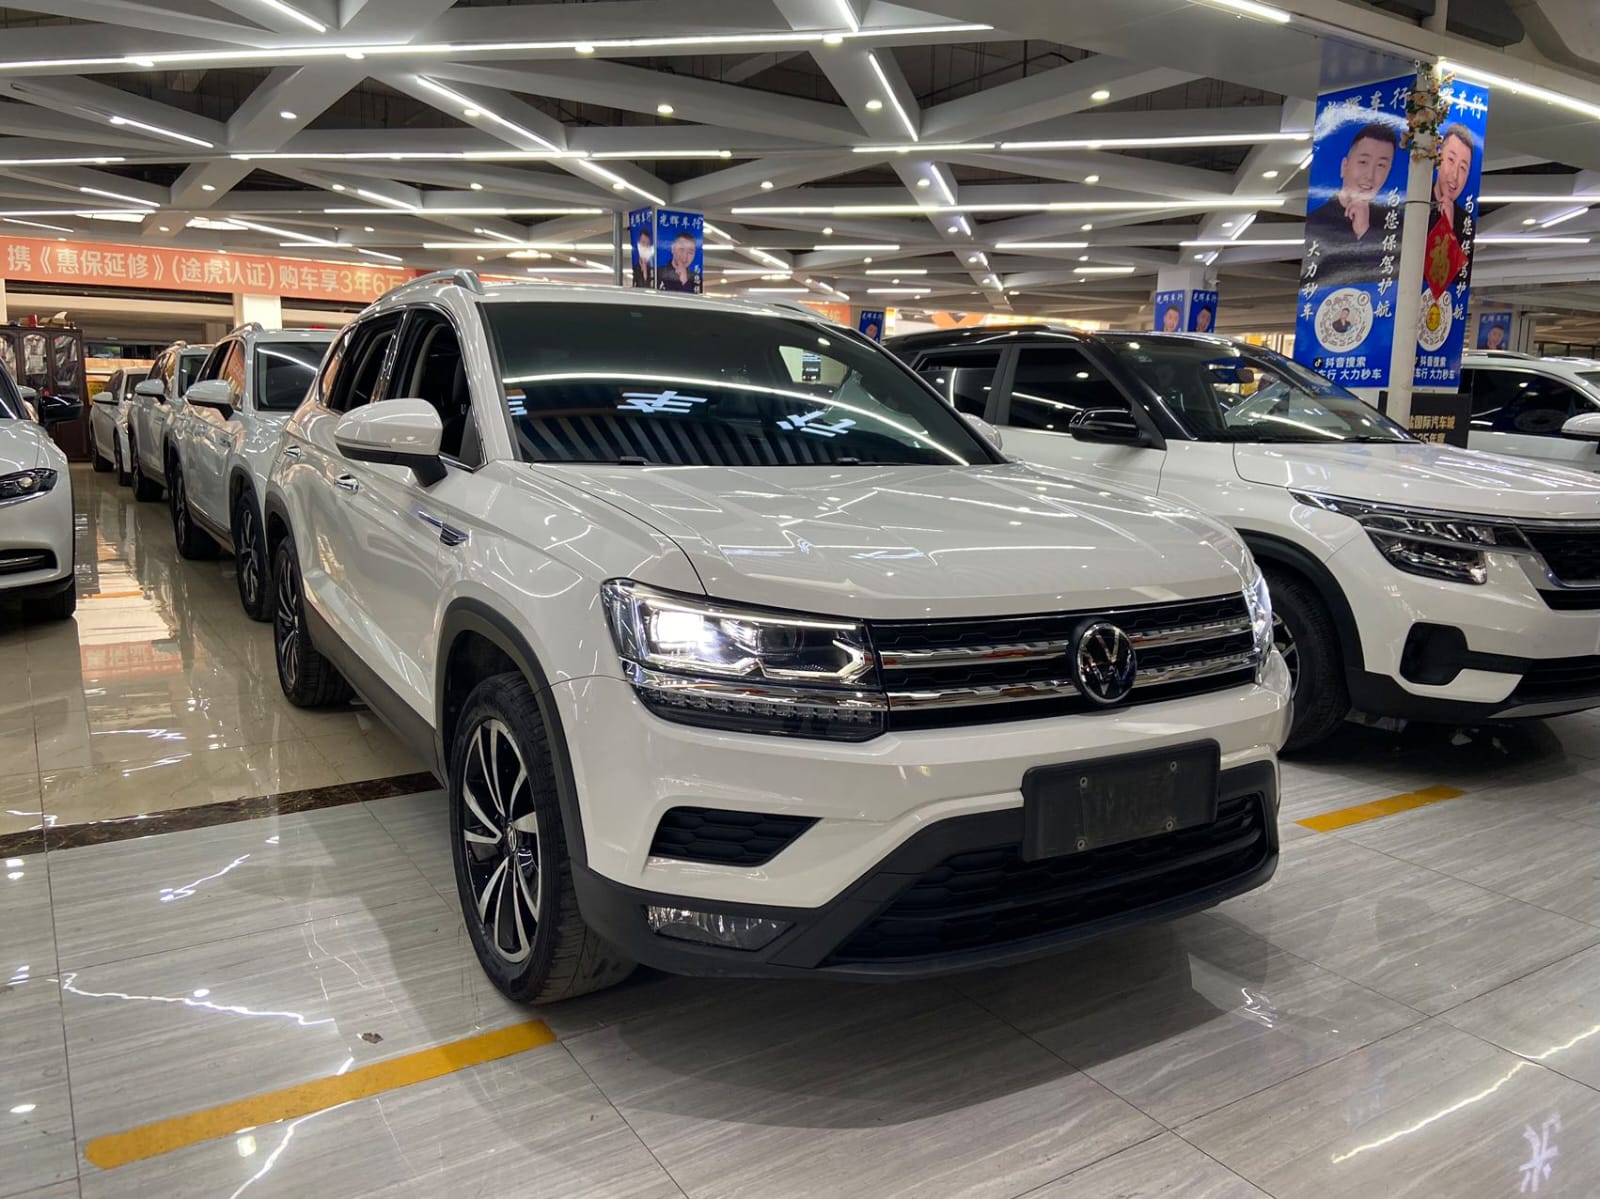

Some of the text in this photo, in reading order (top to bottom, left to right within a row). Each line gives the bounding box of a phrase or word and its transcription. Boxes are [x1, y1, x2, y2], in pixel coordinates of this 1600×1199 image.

[1373, 187, 1400, 318] 为您保驾护航
[7, 245, 415, 295] 携《惠保延修》(途虎认证)购车享3年6万
[1300, 240, 1320, 320] 大力秒车
[1325, 356, 1367, 368] 抖音搜索
[1340, 368, 1382, 381] 大力秒车
[1420, 355, 1447, 367] 抖音搜索
